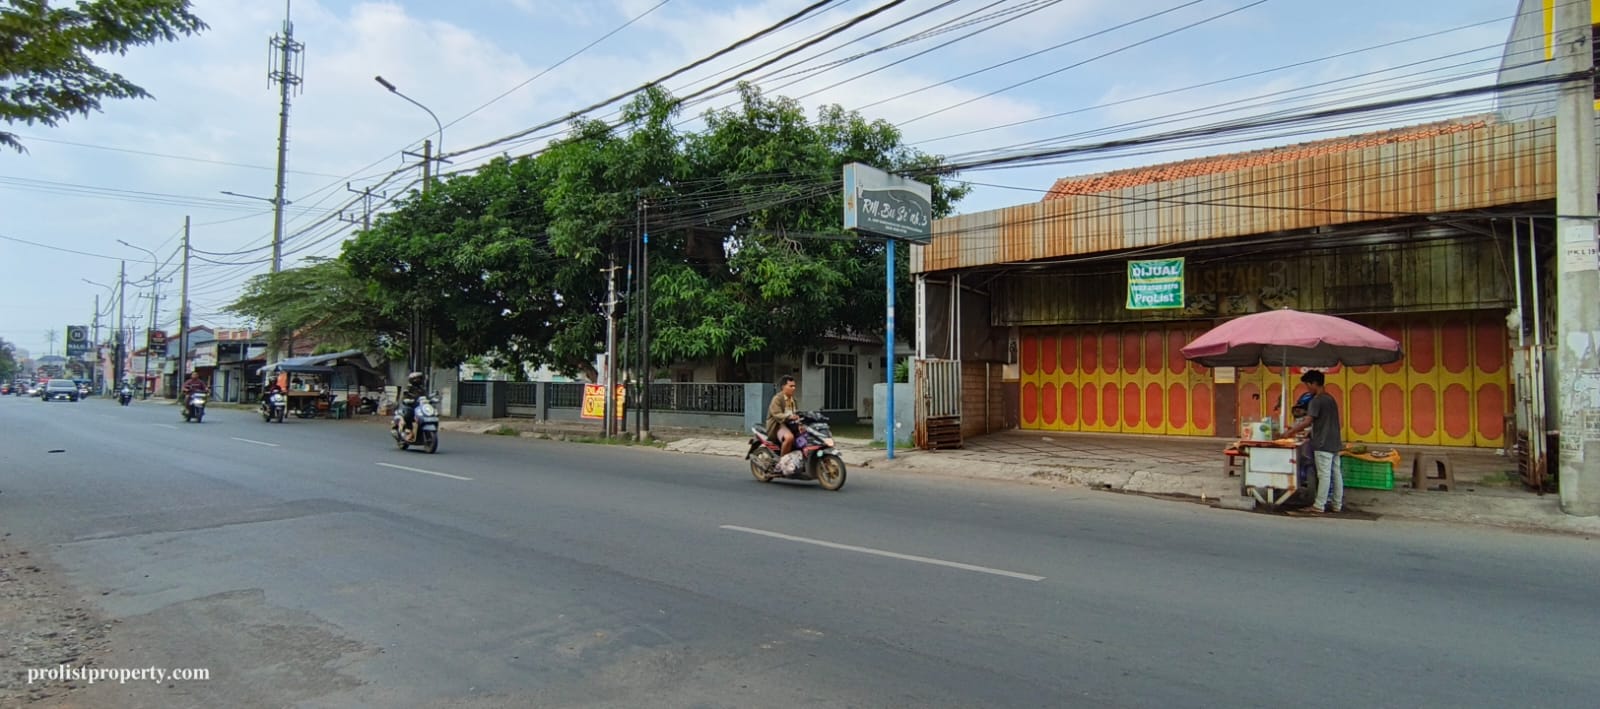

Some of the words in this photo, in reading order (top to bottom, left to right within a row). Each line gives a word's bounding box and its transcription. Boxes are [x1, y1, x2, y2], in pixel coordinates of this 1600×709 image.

[1132, 265, 1179, 277] DIJUAL
[1187, 271, 1198, 294] U
[1135, 293, 1175, 304] ProList
